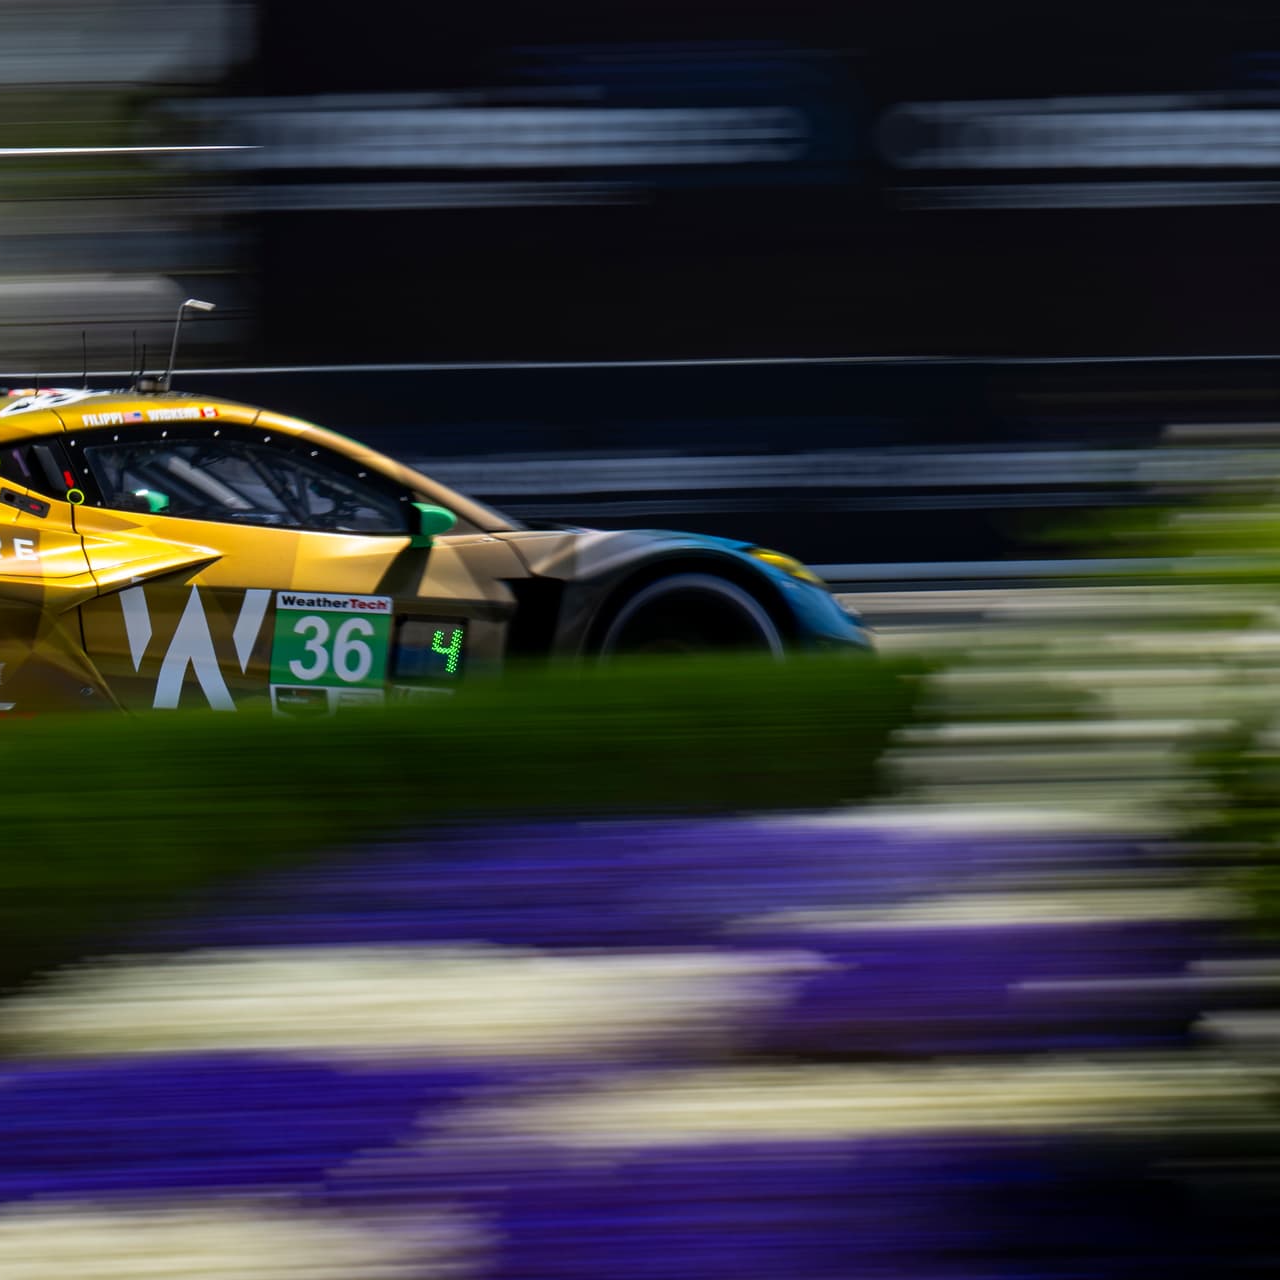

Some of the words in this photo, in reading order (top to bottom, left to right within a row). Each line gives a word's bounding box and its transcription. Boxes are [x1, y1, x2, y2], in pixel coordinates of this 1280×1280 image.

[82, 412, 123, 427] FILIPPI
[281, 595, 389, 610] WeatherTech
[289, 615, 375, 683] 36
[431, 628, 464, 674] 4
